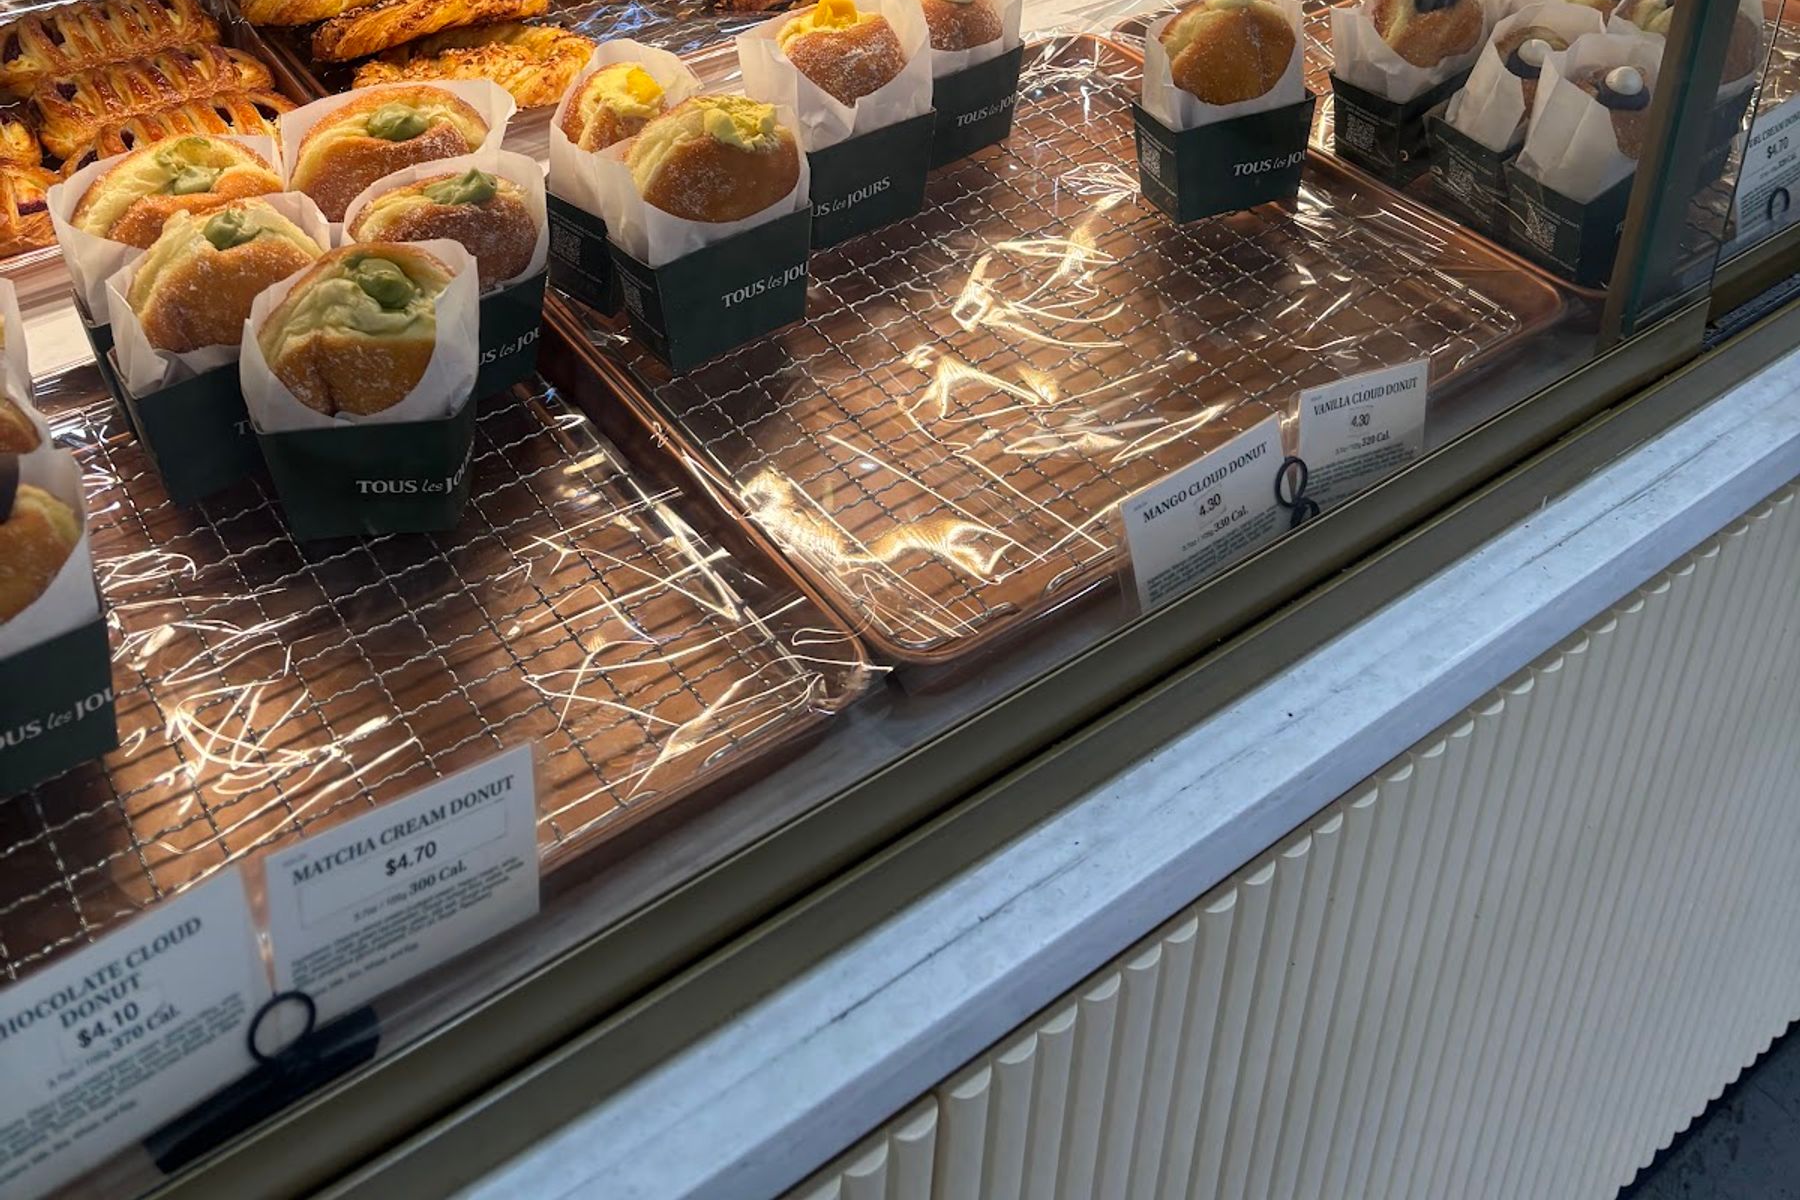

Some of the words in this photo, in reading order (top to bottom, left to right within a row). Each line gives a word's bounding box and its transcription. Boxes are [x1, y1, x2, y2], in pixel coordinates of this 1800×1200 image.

[956, 106, 988, 127] TOUS
[1233, 159, 1272, 177] TOUS
[847, 176, 891, 209] JOURS
[721, 279, 766, 307] TOUS
[767, 275, 782, 289] les
[499, 344, 516, 357] les
[1313, 395, 1351, 416] VANILLA
[1351, 386, 1385, 404] CLOUD
[1385, 377, 1418, 396] DONUT
[356, 479, 418, 493] TOUS
[421, 479, 443, 492] les
[1143, 490, 1187, 523] MANGO
[1189, 467, 1228, 497] CLOUD
[1229, 441, 1268, 473] DONUT
[1199, 493, 1222, 516] 4.30
[1231, 505, 1249, 522] Cal.
[47, 712, 72, 730] les
[292, 837, 376, 886] MATCHA
[379, 805, 447, 845] CREAM
[449, 774, 514, 816] DONUT
[385, 840, 437, 877] $4.70
[409, 875, 436, 895] 300
[438, 860, 468, 881] Cal.
[125, 917, 202, 969] CLOUD
[60, 972, 141, 1029] DONUT
[78, 1001, 139, 1048] $4.10
[112, 1025, 144, 1050] 370
[146, 1004, 181, 1031] Cal.
